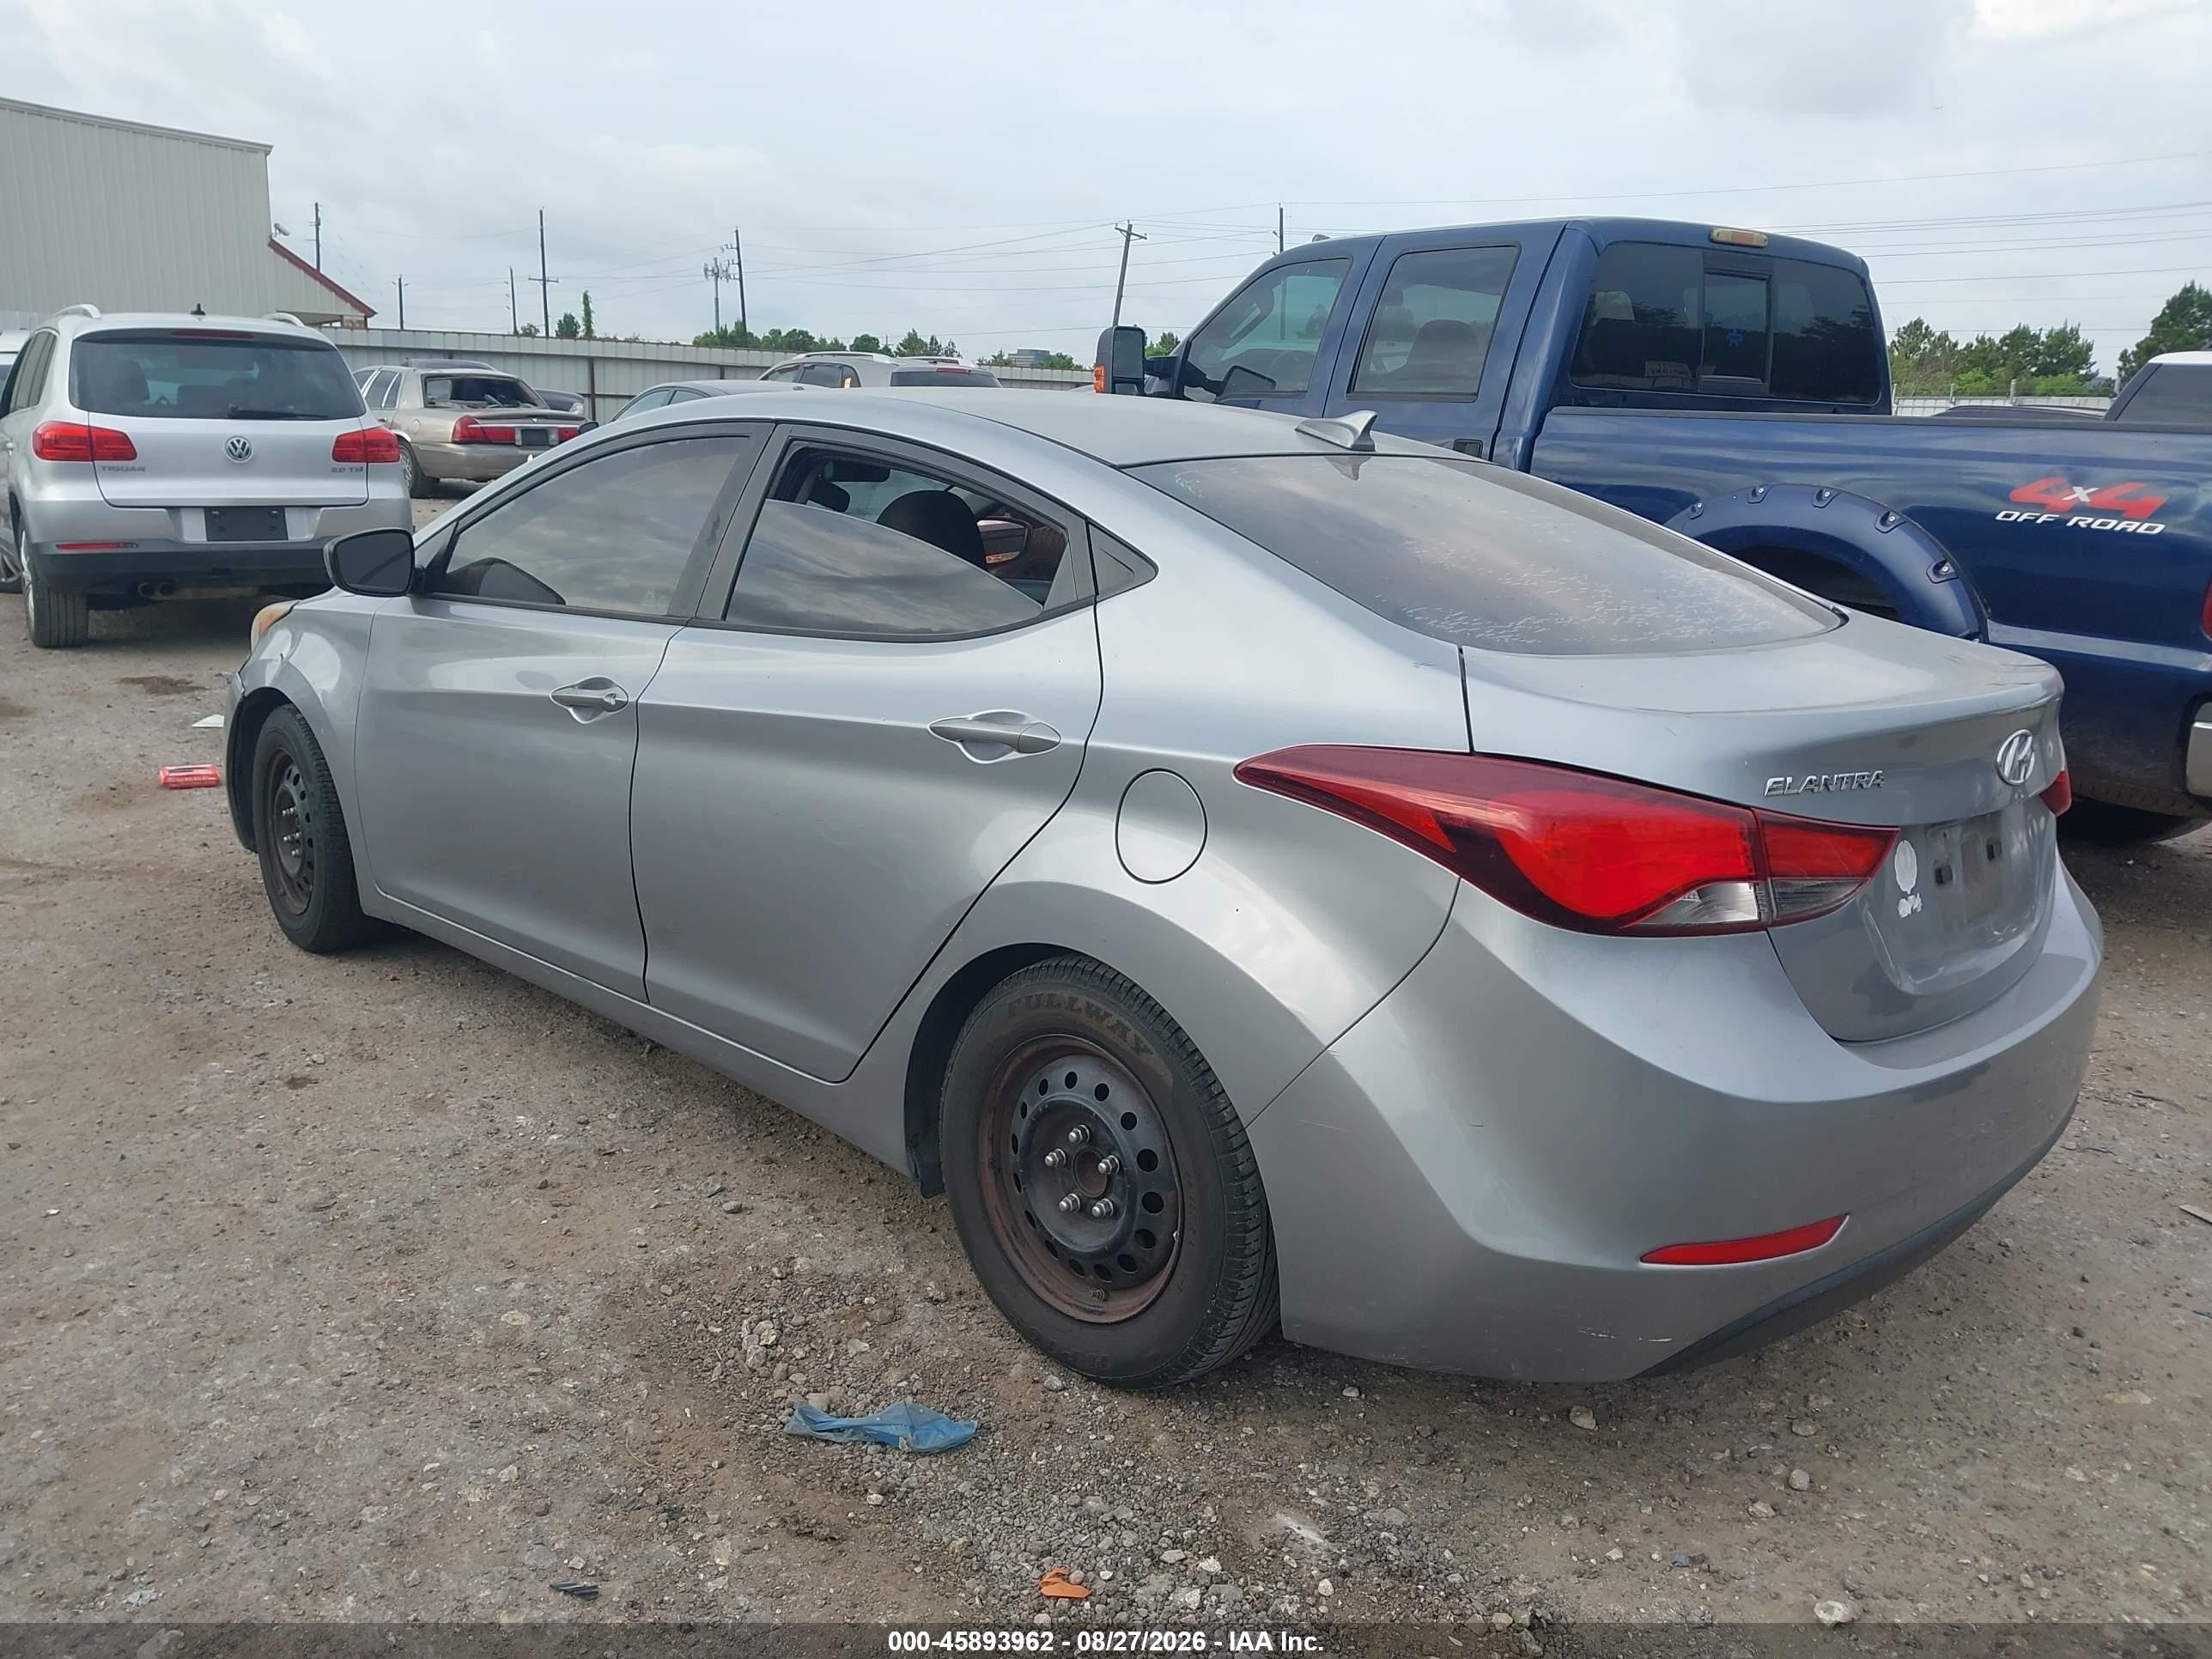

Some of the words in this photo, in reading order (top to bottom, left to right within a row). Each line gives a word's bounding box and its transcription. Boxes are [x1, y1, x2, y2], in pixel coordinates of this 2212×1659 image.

[1995, 510, 2060, 524] OFF
[2066, 516, 2166, 535] ROAD
[1764, 770, 1885, 797] ELANTRA
[1007, 993, 1154, 1055] FULLWAY
